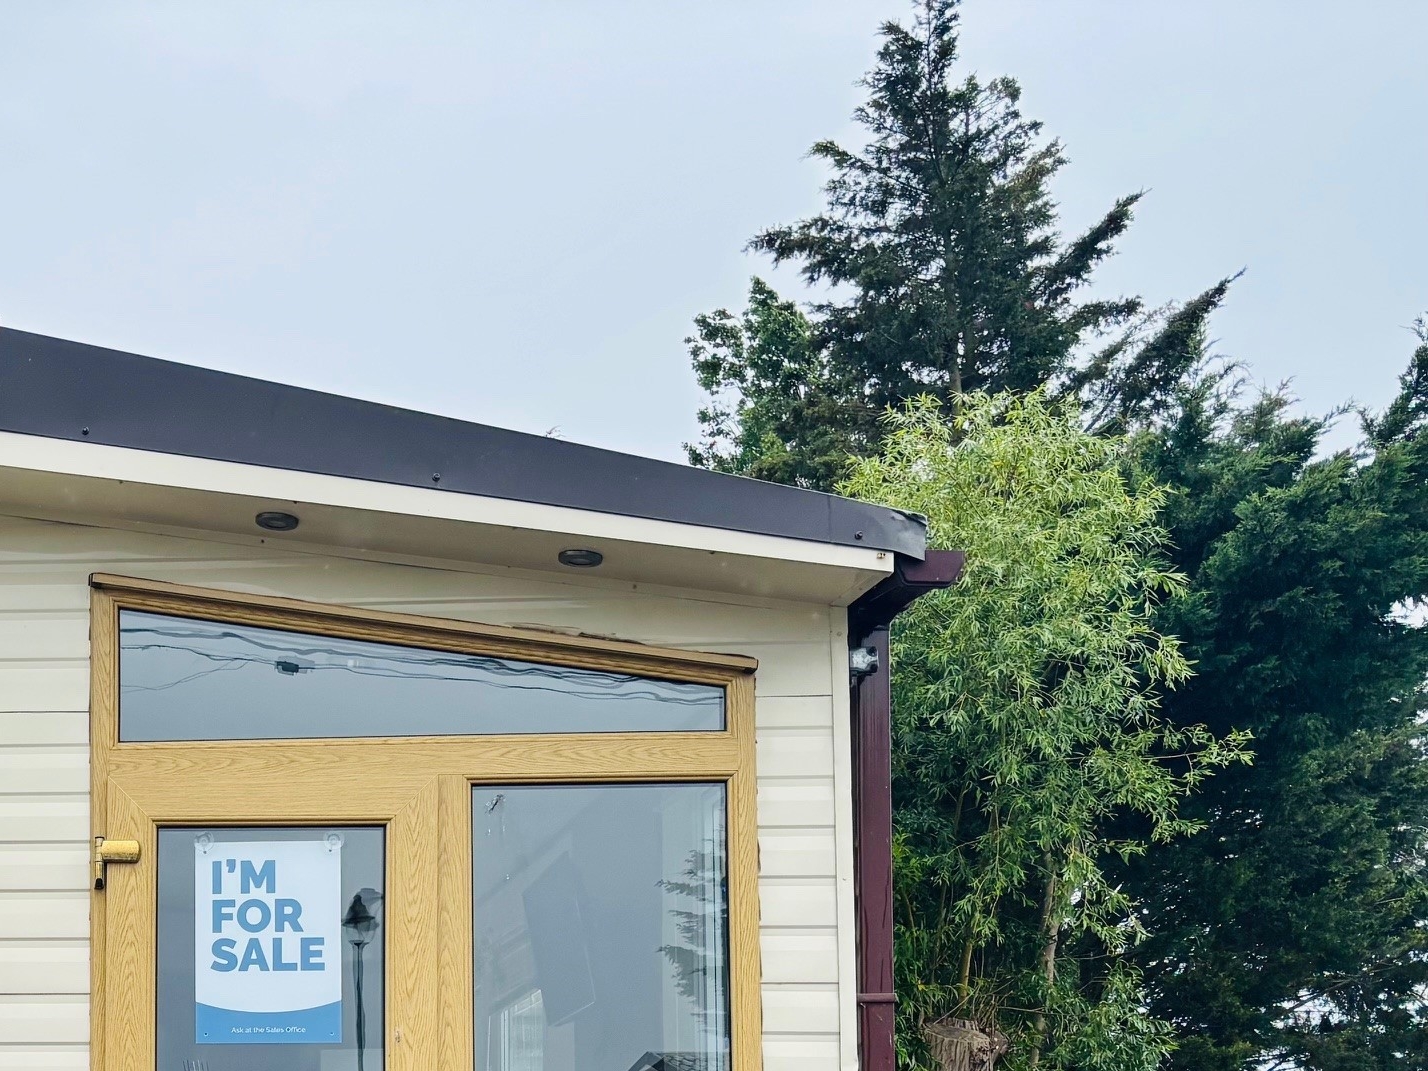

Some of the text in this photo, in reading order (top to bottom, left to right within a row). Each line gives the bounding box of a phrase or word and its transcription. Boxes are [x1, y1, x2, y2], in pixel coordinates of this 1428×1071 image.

[212, 859, 276, 894] I'M
[212, 899, 304, 933] FOR
[210, 937, 325, 972] SALE
